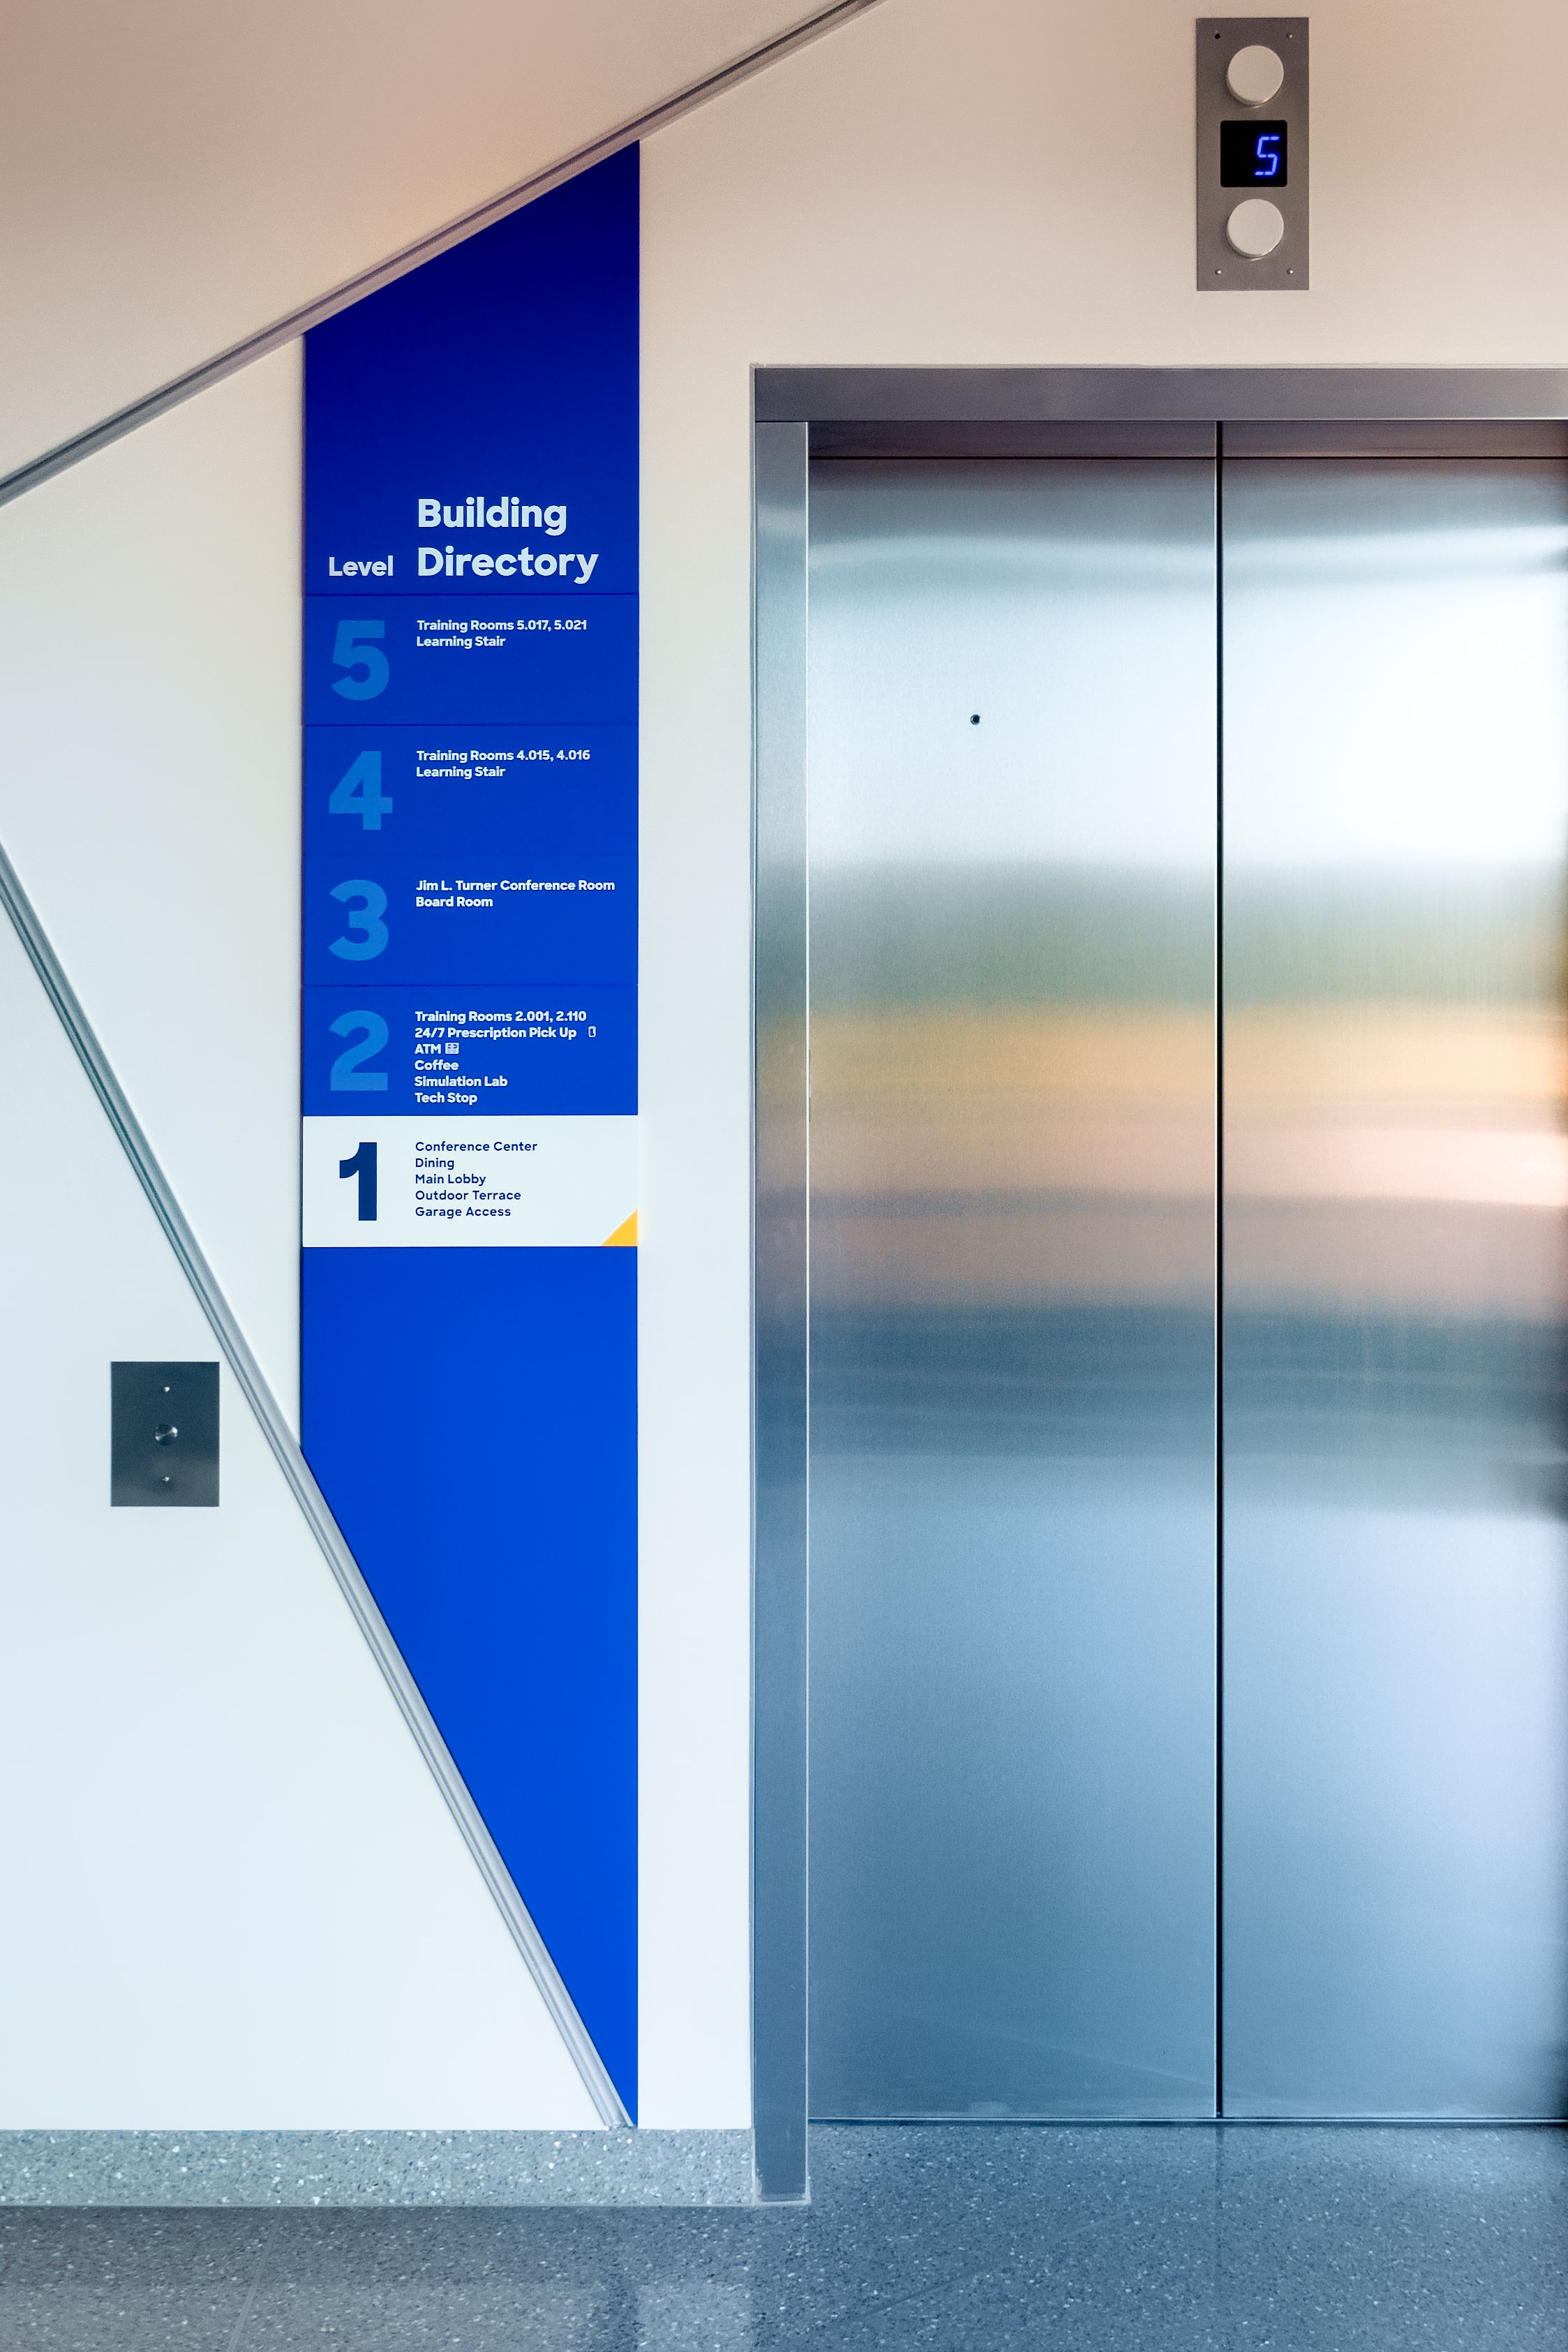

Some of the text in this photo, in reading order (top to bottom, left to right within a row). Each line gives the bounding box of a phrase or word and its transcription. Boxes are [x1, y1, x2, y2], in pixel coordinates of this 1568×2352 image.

[1255, 135, 1279, 176] 5
[419, 497, 566, 536] Building
[329, 556, 393, 576] Level
[419, 546, 599, 584] Directory
[417, 620, 586, 633] Training Rooms 5.017, 5.021
[417, 636, 506, 649] Learning Stair
[331, 620, 389, 700] 5
[417, 750, 590, 763] Training Rooms 4.015, 4.016
[417, 766, 505, 779] Learning Stair
[329, 751, 393, 830] 4
[416, 879, 615, 891] Jim L. Turner Conference Room
[417, 896, 493, 907] Board Room
[329, 879, 389, 960] 3
[415, 1011, 586, 1024] Training Rooms 2.001, 2.110
[415, 1027, 576, 1040] 24/7 Prescription Pick Up
[329, 1011, 389, 1091] 2
[415, 1044, 441, 1054] ATM
[415, 1059, 458, 1070] Coffee
[415, 1075, 507, 1086] Simulation Lab
[415, 1092, 477, 1105] Tech Stop
[416, 1141, 537, 1151] Conference Center
[416, 1158, 454, 1170] Dining
[339, 1142, 377, 1221] 1
[416, 1174, 486, 1186] Main Lobby
[416, 1190, 521, 1200] Outdoor Terrace
[416, 1207, 511, 1219] Garage Access
